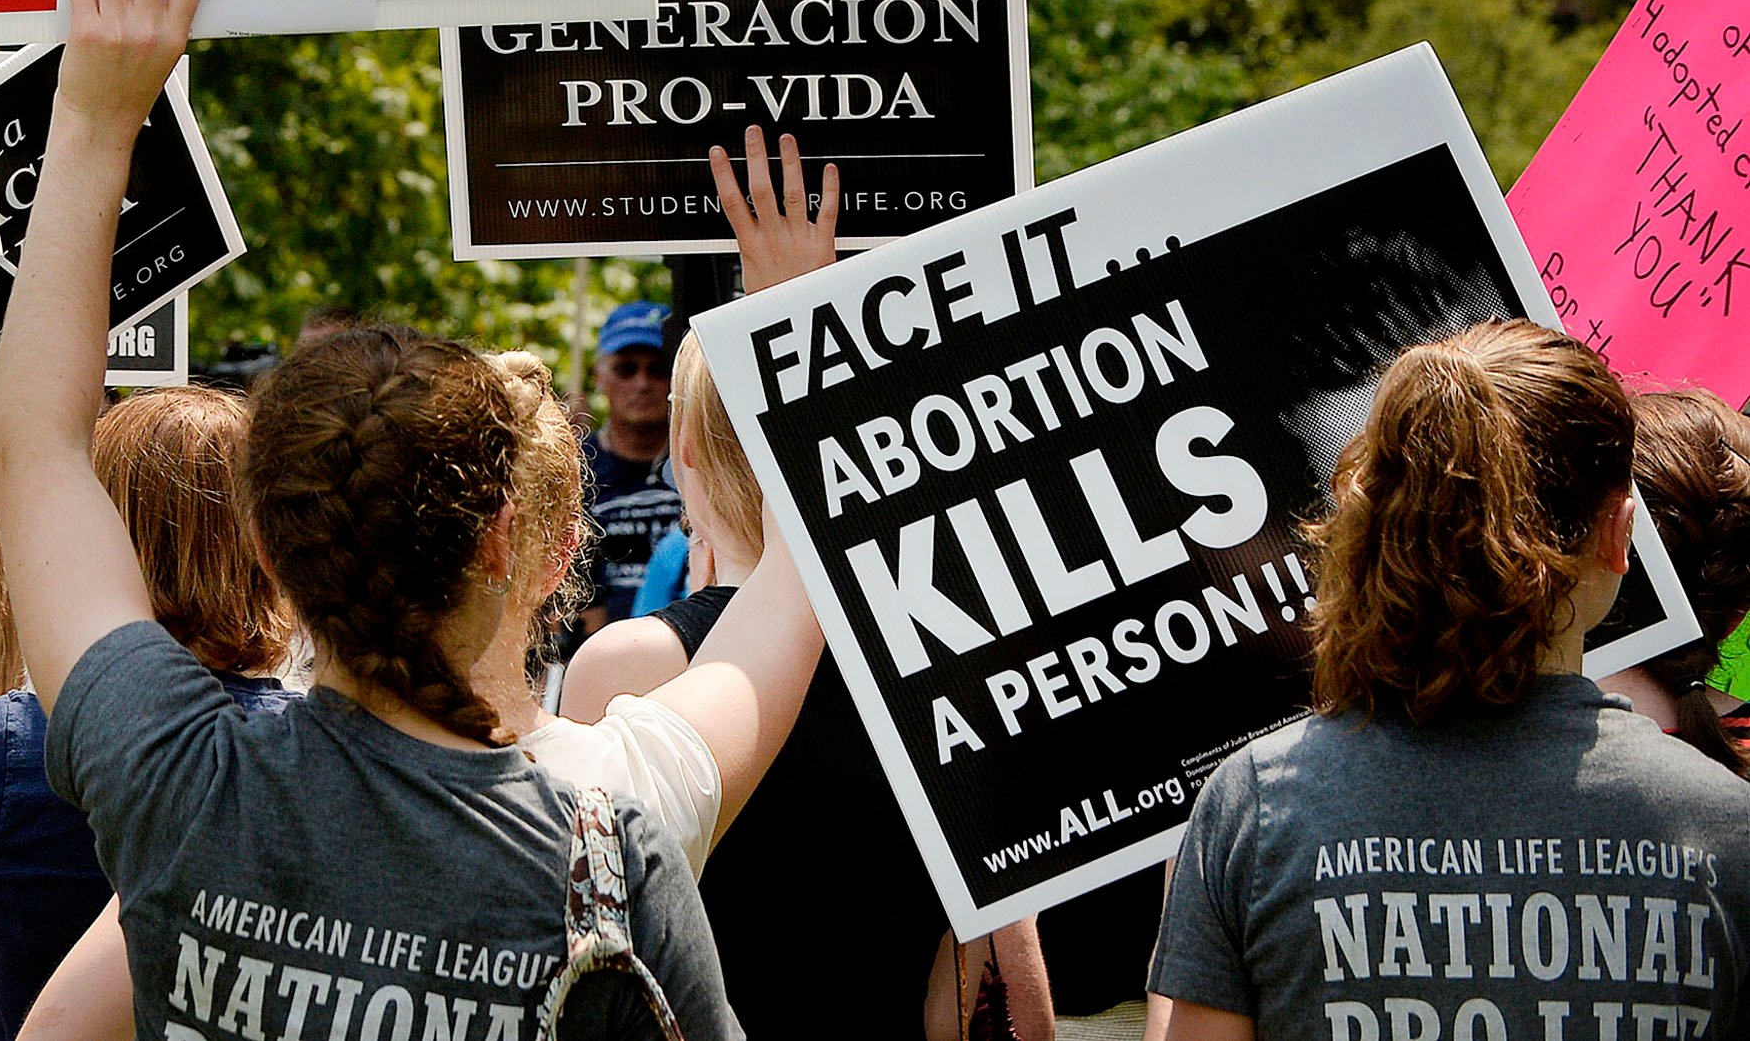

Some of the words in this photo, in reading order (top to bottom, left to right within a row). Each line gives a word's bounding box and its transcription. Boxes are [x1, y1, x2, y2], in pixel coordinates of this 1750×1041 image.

[560, 72, 935, 126] PRO-VIDA
[748, 251, 981, 414] FACE
[817, 299, 1209, 517] ABORTION
[845, 405, 1268, 678] KILLS
[929, 696, 984, 765] A
[983, 774, 1186, 873] www.ALL.org
[1314, 836, 1484, 881] AMERICAN
[1497, 838, 1562, 875] LIFE
[1578, 838, 1719, 889] LEAGUE'S
[191, 888, 353, 958] AMERICAN
[360, 927, 427, 973] LIFE
[1313, 891, 1716, 990] NATIONAL
